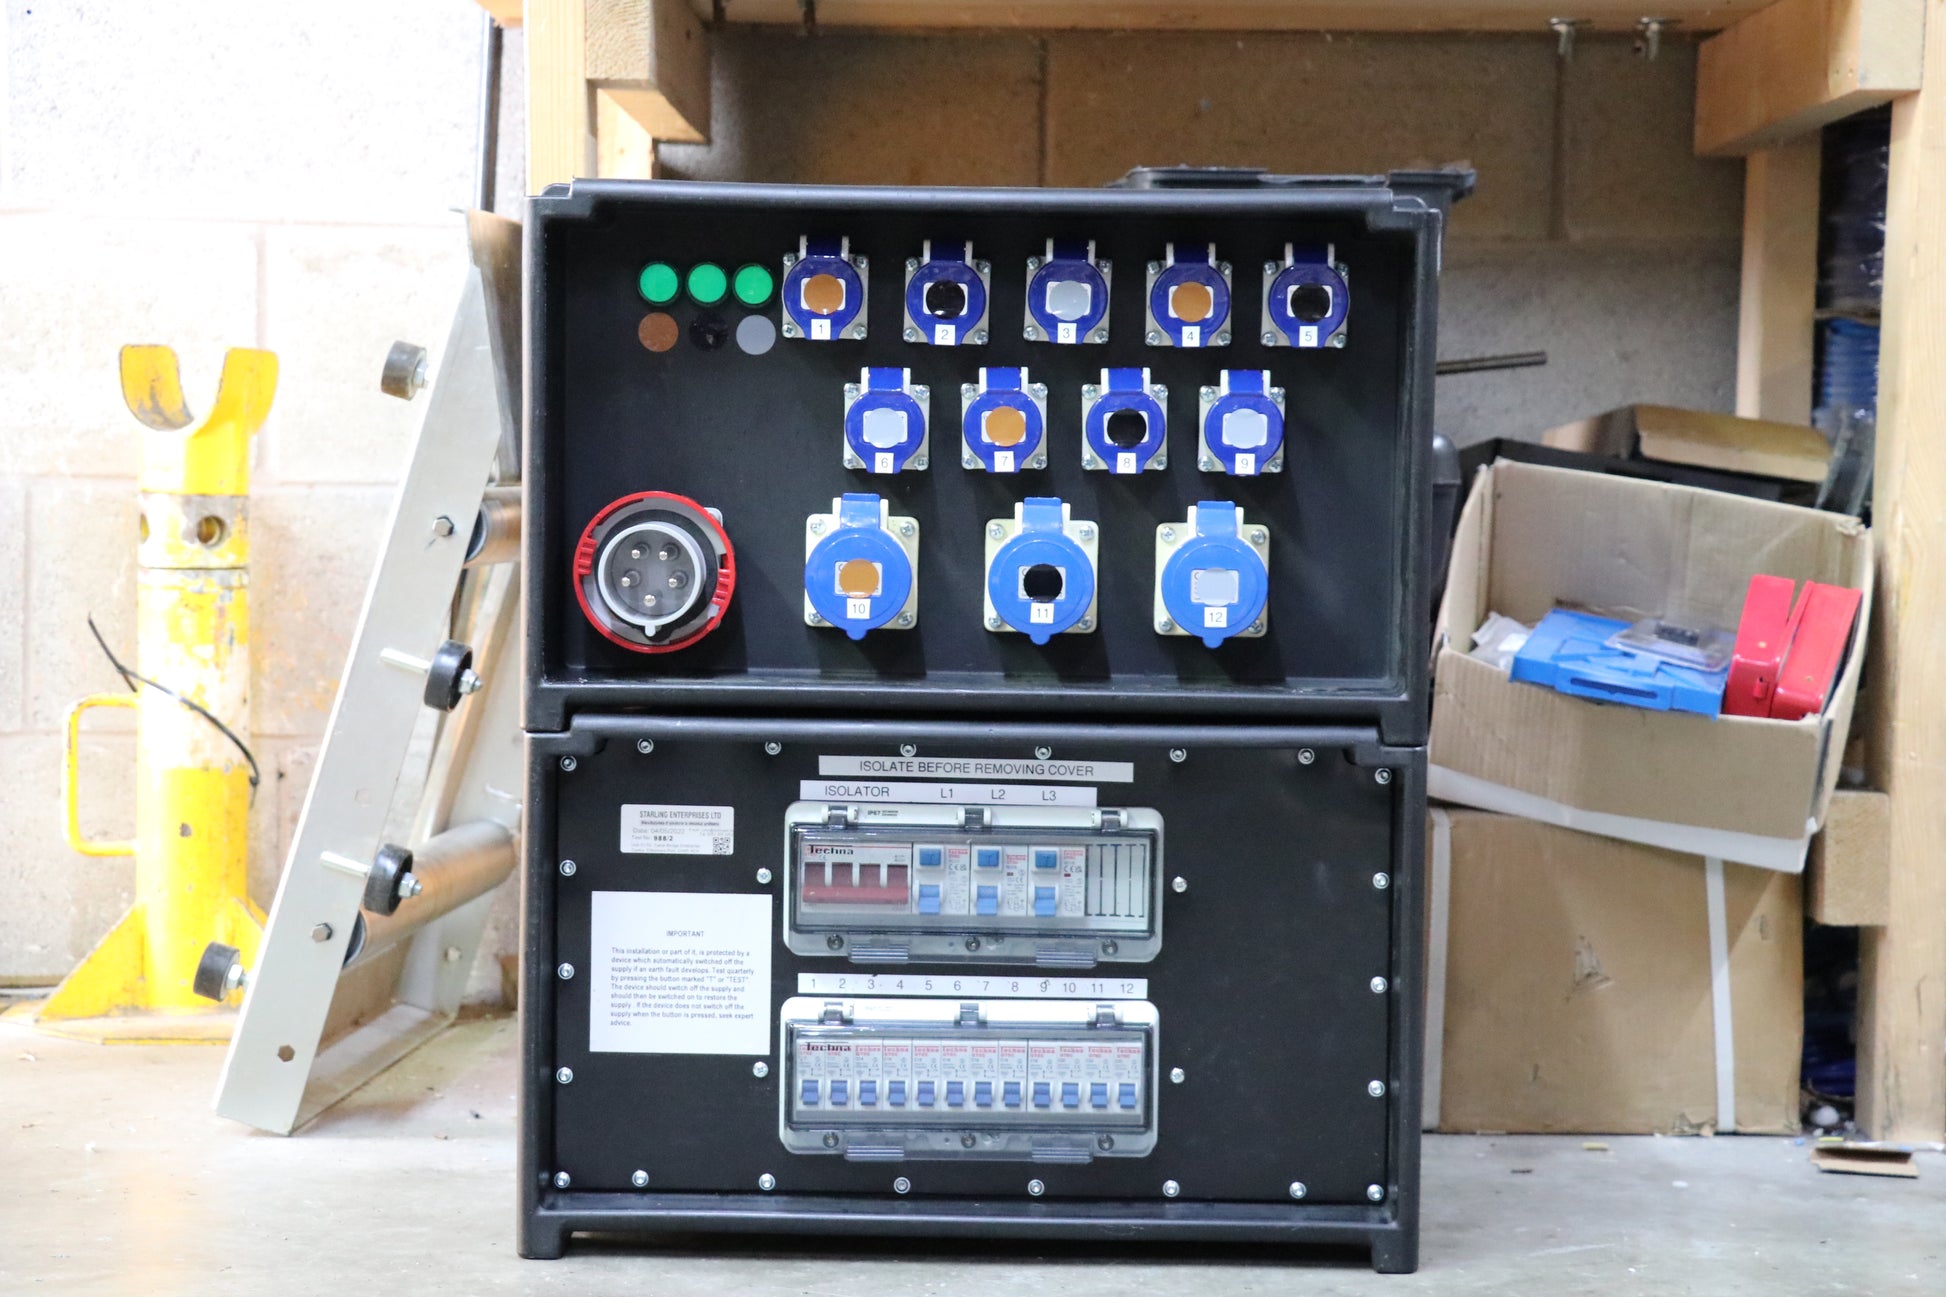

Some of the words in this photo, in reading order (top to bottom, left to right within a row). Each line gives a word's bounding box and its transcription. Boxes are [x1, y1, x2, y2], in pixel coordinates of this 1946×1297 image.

[818, 324, 824, 335] 1
[941, 330, 948, 340] 2
[1062, 327, 1070, 338] 3
[1186, 331, 1195, 341] 4
[1304, 330, 1312, 341] 5
[880, 457, 888, 468] 6
[1000, 455, 1008, 466] 7
[1123, 457, 1131, 468] 8
[1240, 458, 1248, 470] 9
[852, 603, 866, 614] 10
[1036, 608, 1049, 619] 11
[1208, 610, 1223, 622] 12
[859, 761, 914, 773] ISOLATE
[918, 762, 971, 774] BEFORE
[974, 763, 1045, 775] REMOVING
[1048, 765, 1094, 776] COVER
[824, 786, 890, 797] ISOLATOR
[940, 788, 953, 799] L1
[991, 789, 1005, 800] L2
[1042, 790, 1057, 801] L3
[639, 810, 668, 818] STARLING
[669, 811, 710, 819] ENTERPRISES
[808, 844, 854, 855] Techna
[612, 947, 625, 955] This
[620, 975, 647, 983] pressing
[812, 979, 816, 989] 1
[839, 979, 845, 989] 2
[867, 979, 875, 990] 3
[896, 979, 904, 990] 4
[925, 980, 933, 991] 5
[953, 980, 961, 991] 6
[982, 980, 990, 991] 7
[1011, 981, 1019, 992] 8
[1040, 981, 1048, 992] 9
[1063, 982, 1076, 993] 10
[1092, 982, 1104, 993] 11
[1120, 983, 1134, 994] 12
[610, 1011, 631, 1019] supply
[805, 1042, 851, 1052] Techna
